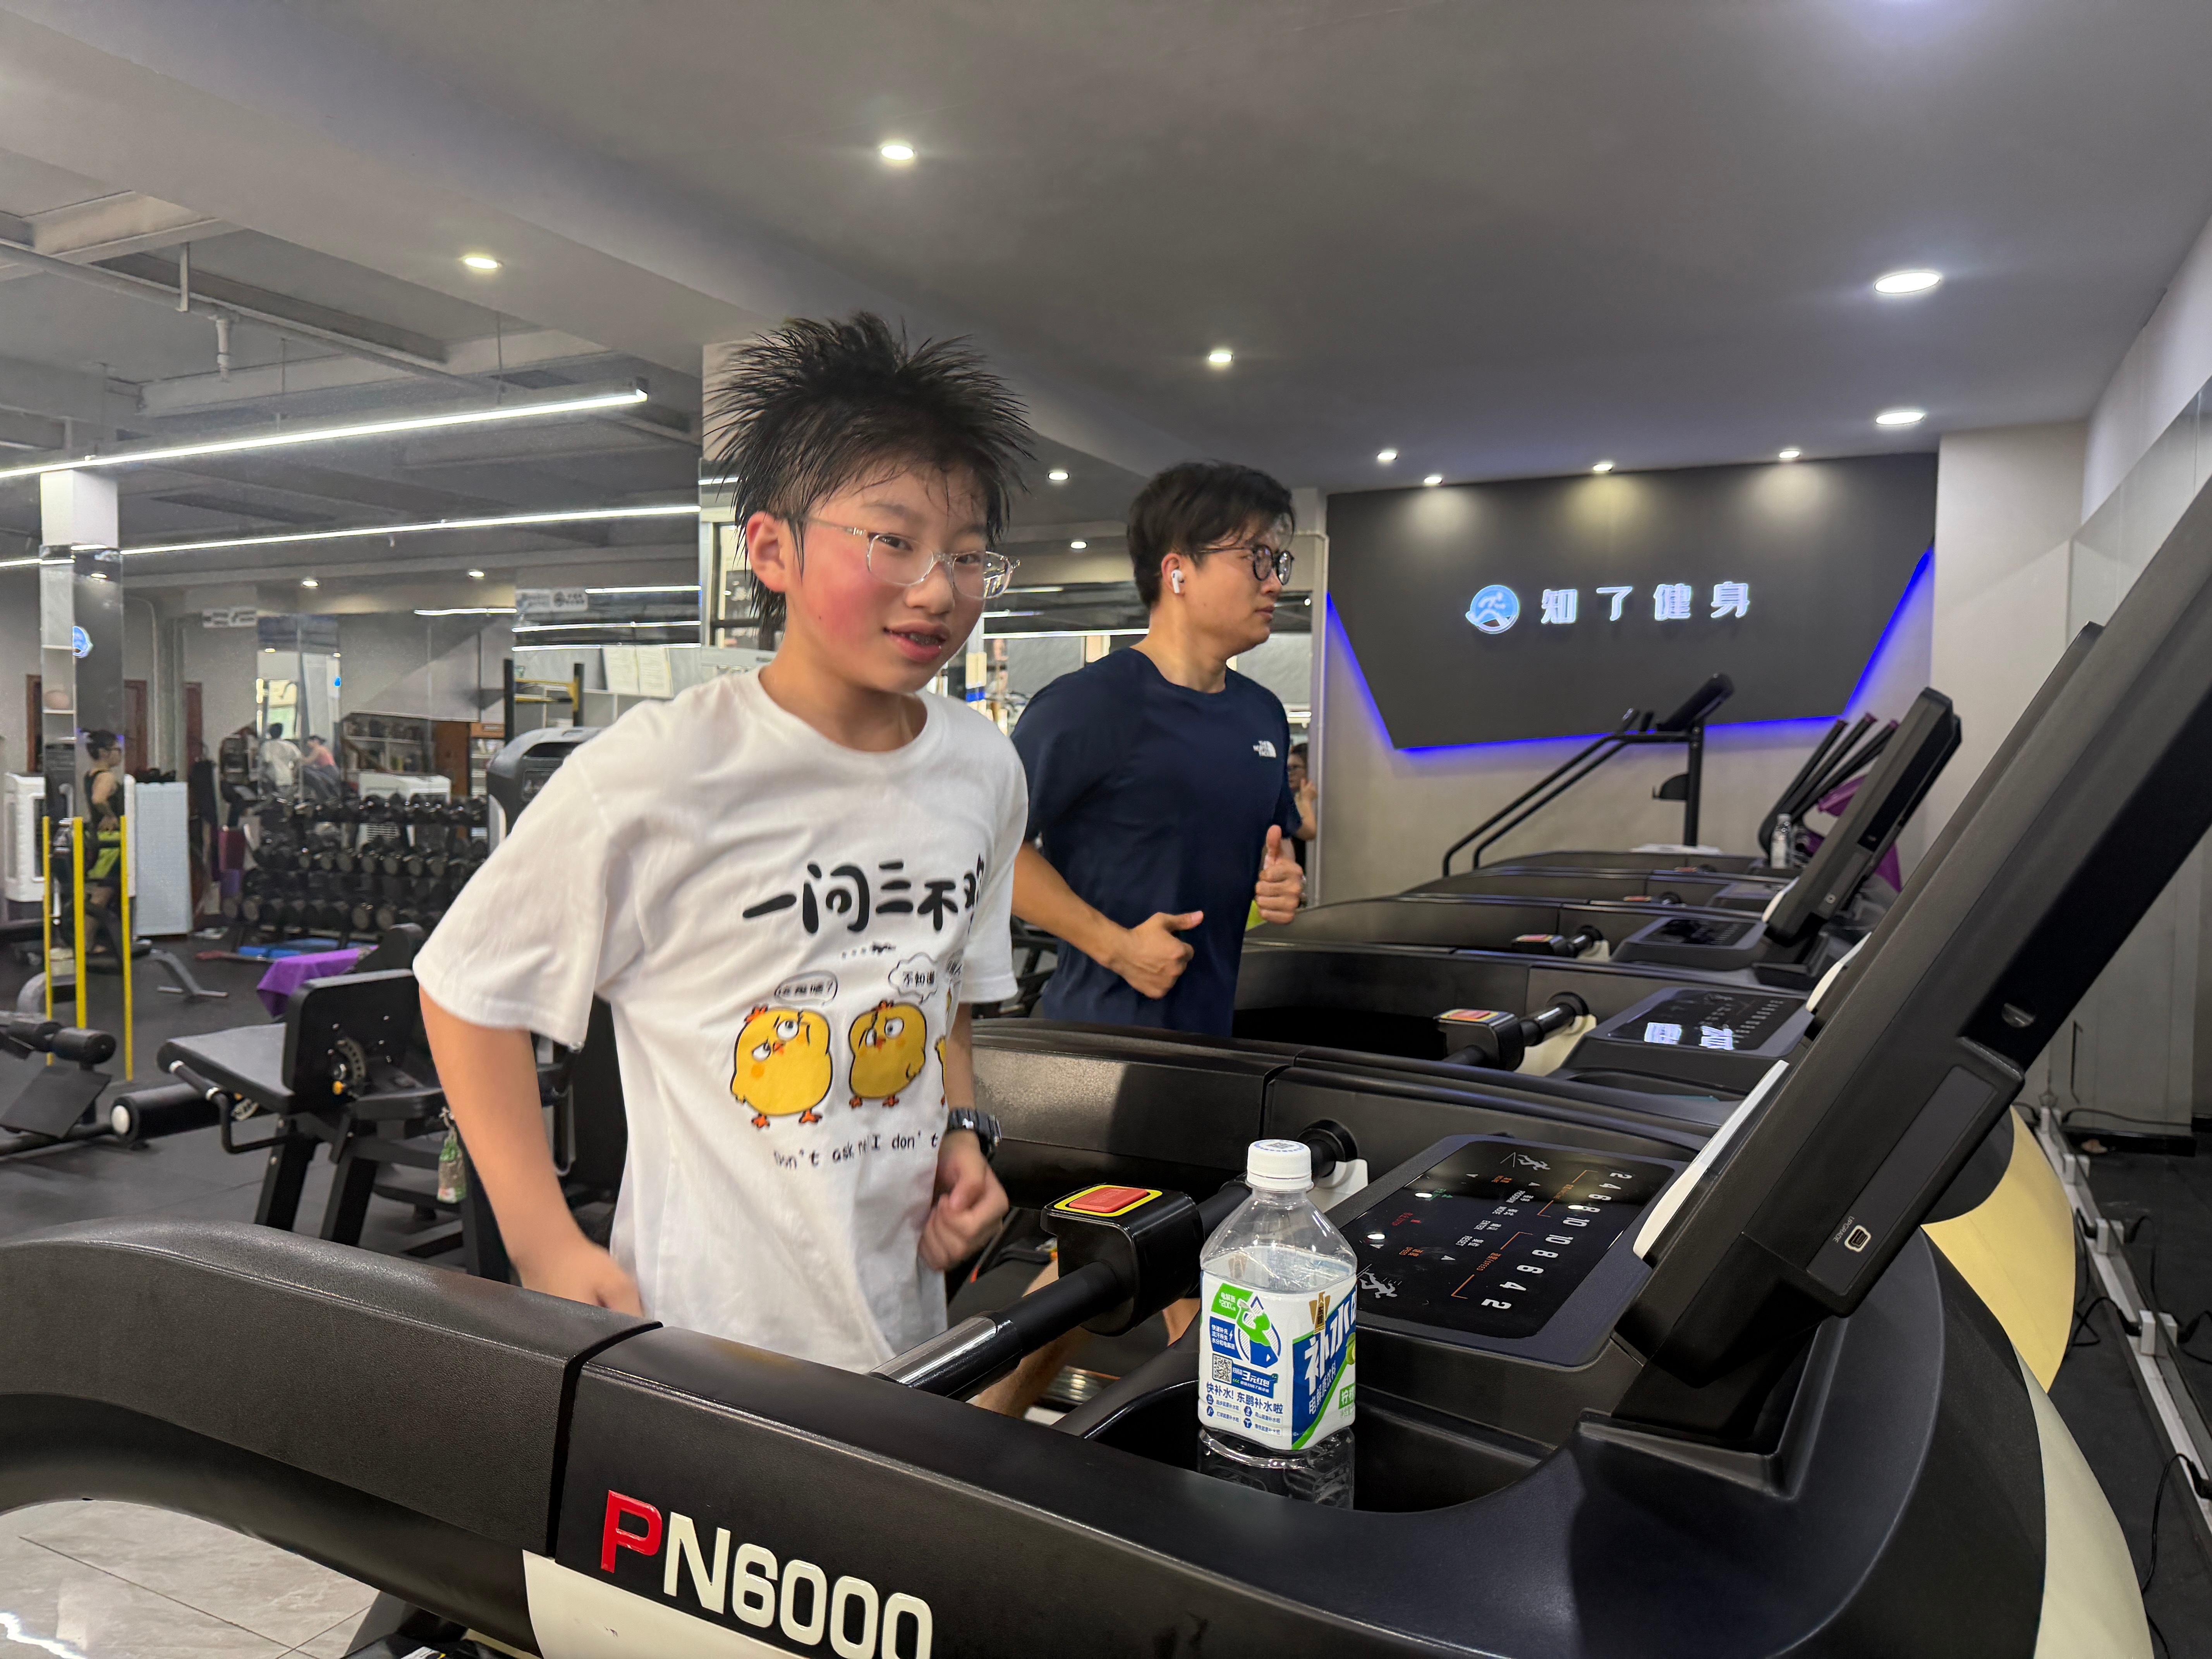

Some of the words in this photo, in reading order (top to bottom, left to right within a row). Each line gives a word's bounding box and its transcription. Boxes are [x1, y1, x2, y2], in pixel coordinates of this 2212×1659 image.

[1540, 581, 1750, 624] 知了健身
[742, 853, 985, 934] 一问三不
[1562, 1217, 1590, 1227] 10
[1832, 1216, 1855, 1243] UPGRADE
[1545, 1234, 1574, 1245] 10
[1532, 1249, 1559, 1258] 8
[1516, 1264, 1544, 1274] 6
[1499, 1281, 1527, 1291] 4
[1481, 1298, 1512, 1309] 2
[1305, 1291, 1356, 1396] 补水
[1237, 1392, 1283, 1414] 东鹏补水啦
[601, 1489, 933, 1659] PN6000
